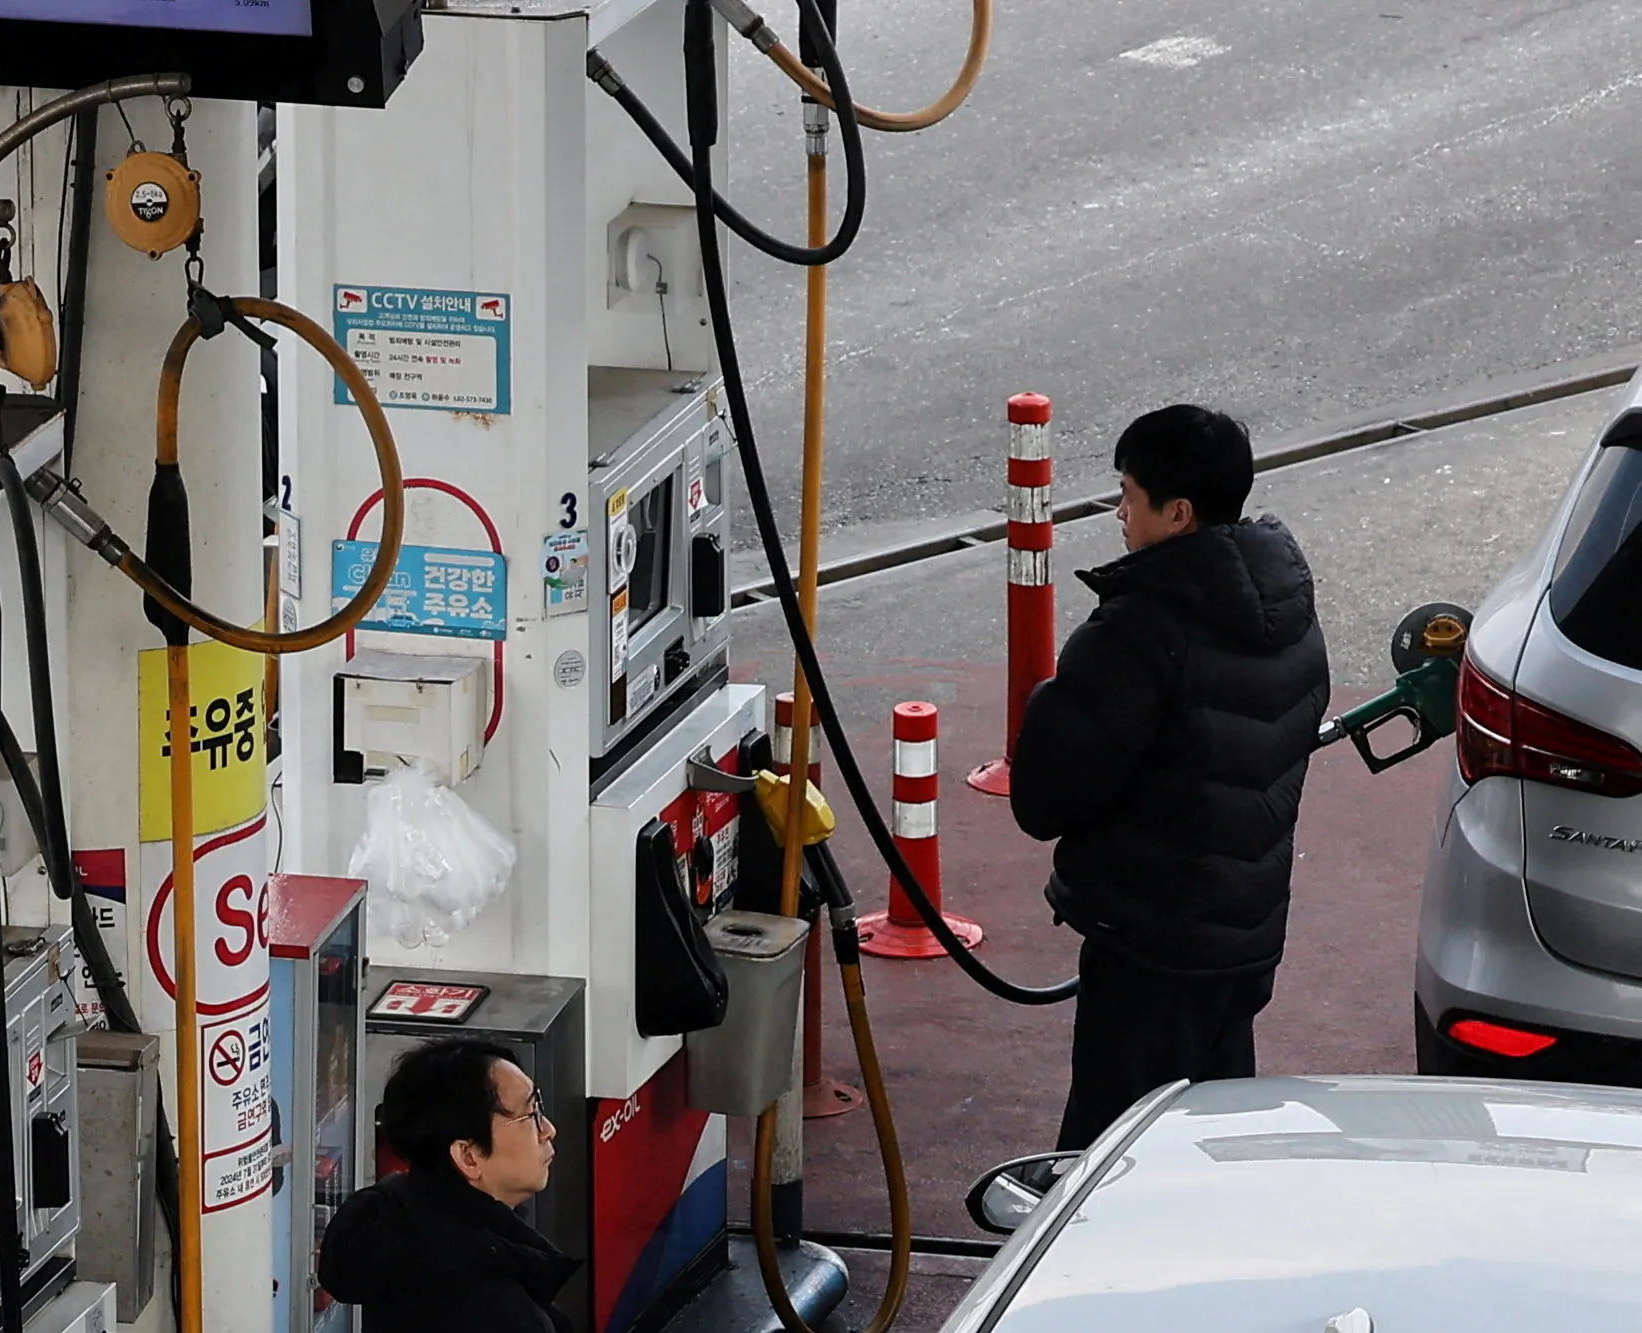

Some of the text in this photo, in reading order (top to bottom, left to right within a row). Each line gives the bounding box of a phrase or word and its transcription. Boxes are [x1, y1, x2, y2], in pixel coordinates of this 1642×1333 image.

[371, 292, 472, 312] CCTV 설치안내
[281, 475, 292, 512] 2
[560, 492, 577, 528] 3
[423, 565, 496, 593] 건강한
[423, 592, 494, 620] 주유소
